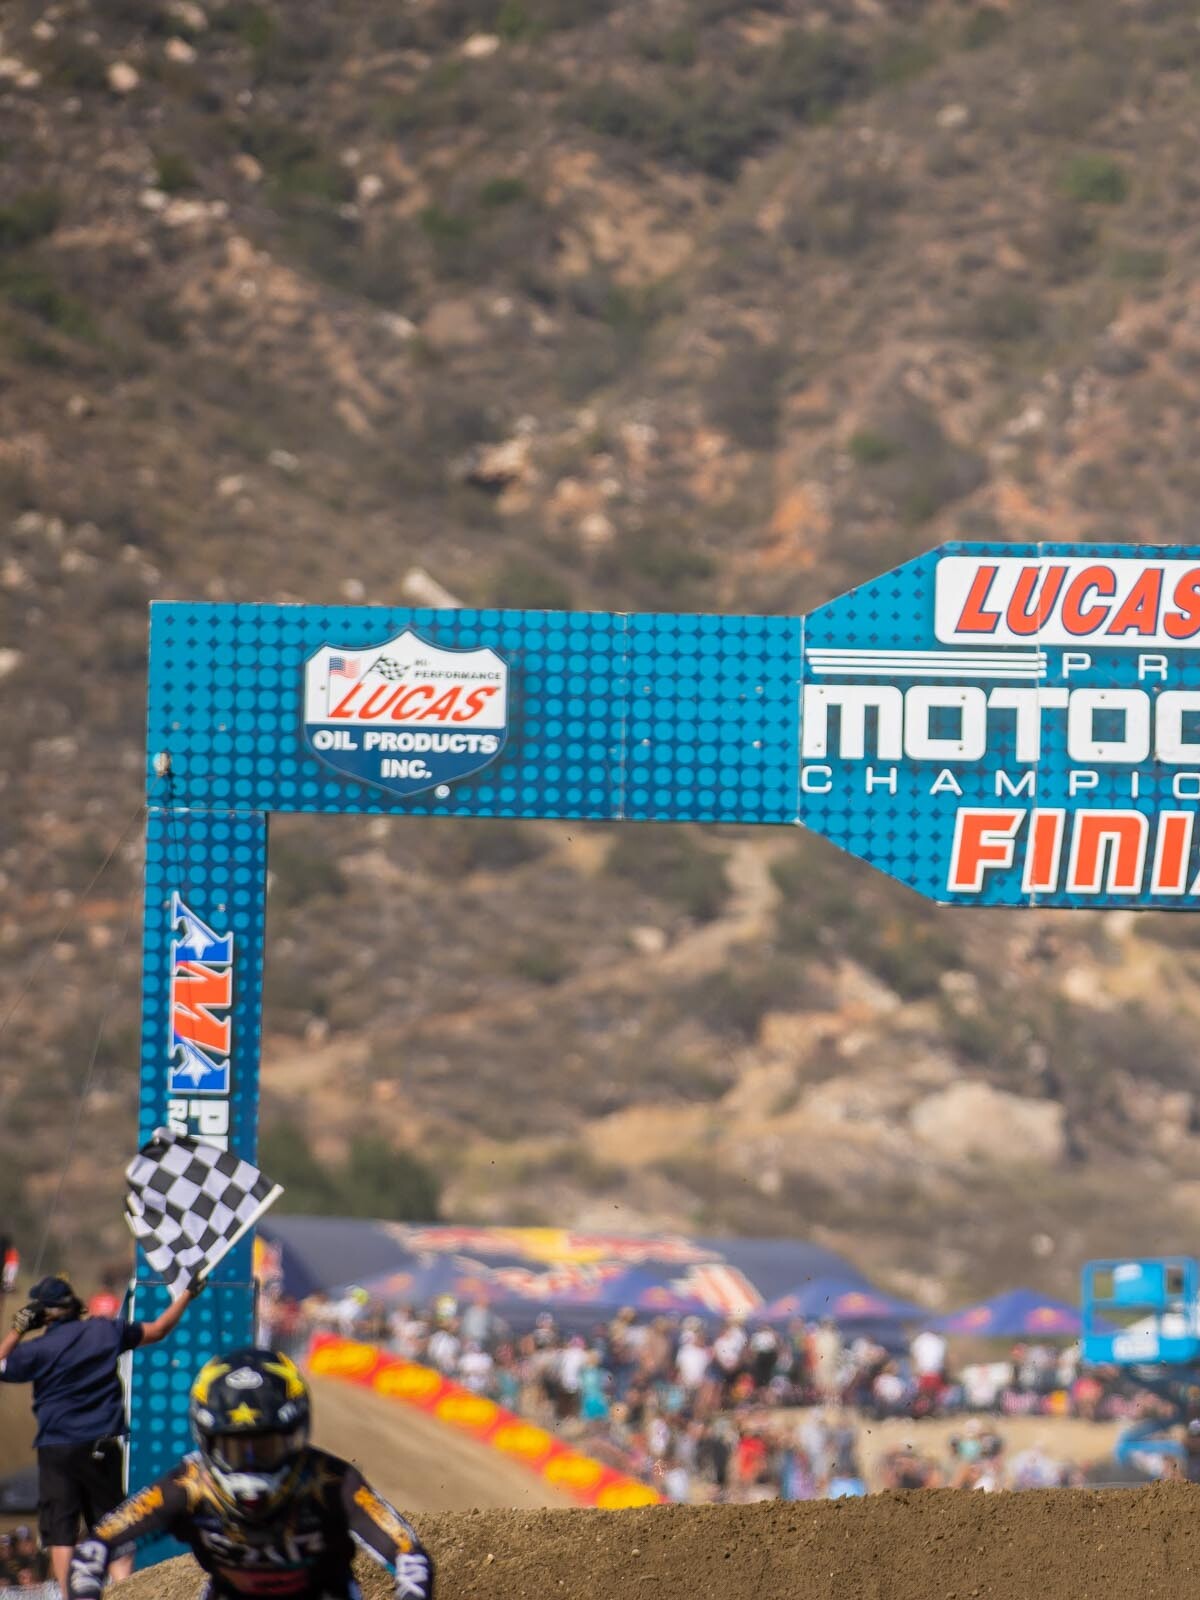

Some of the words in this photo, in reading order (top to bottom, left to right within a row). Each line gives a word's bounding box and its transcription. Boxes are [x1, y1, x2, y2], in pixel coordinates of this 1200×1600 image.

[414, 670, 502, 681] PERFORMANCE
[328, 682, 499, 722] LUCAS
[312, 729, 358, 751] OIL
[363, 731, 499, 754] PRODUCTS
[380, 758, 433, 779] INC.
[168, 890, 234, 1095] AMA
